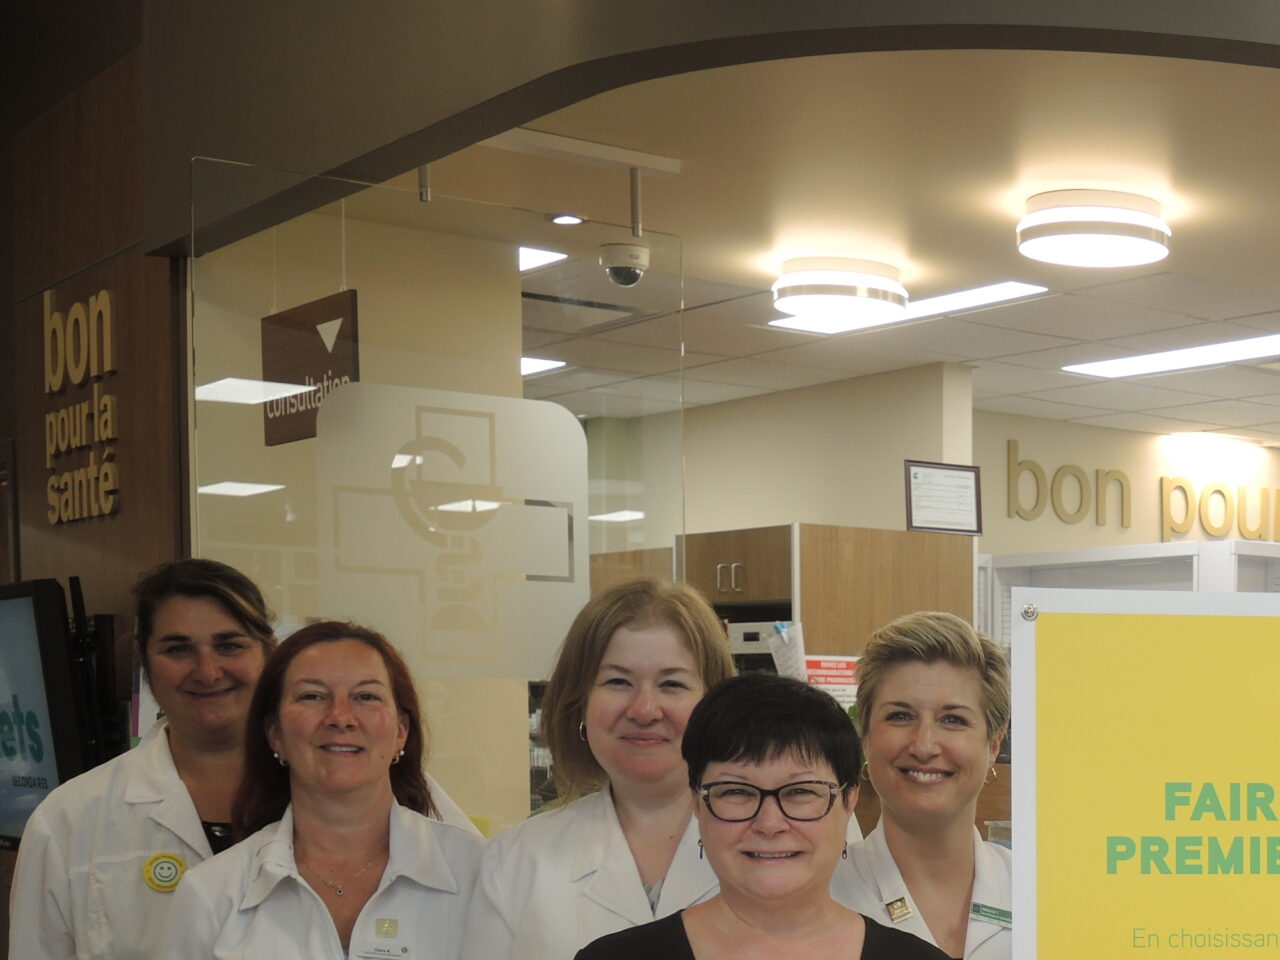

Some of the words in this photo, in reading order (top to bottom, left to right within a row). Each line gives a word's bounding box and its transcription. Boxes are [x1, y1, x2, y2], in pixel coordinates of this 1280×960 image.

[43, 289, 117, 394] bon
[46, 402, 91, 468] pour
[92, 383, 118, 442] la
[47, 447, 119, 525] santé
[1007, 440, 1132, 529] bon
[1133, 928, 1159, 948] En
